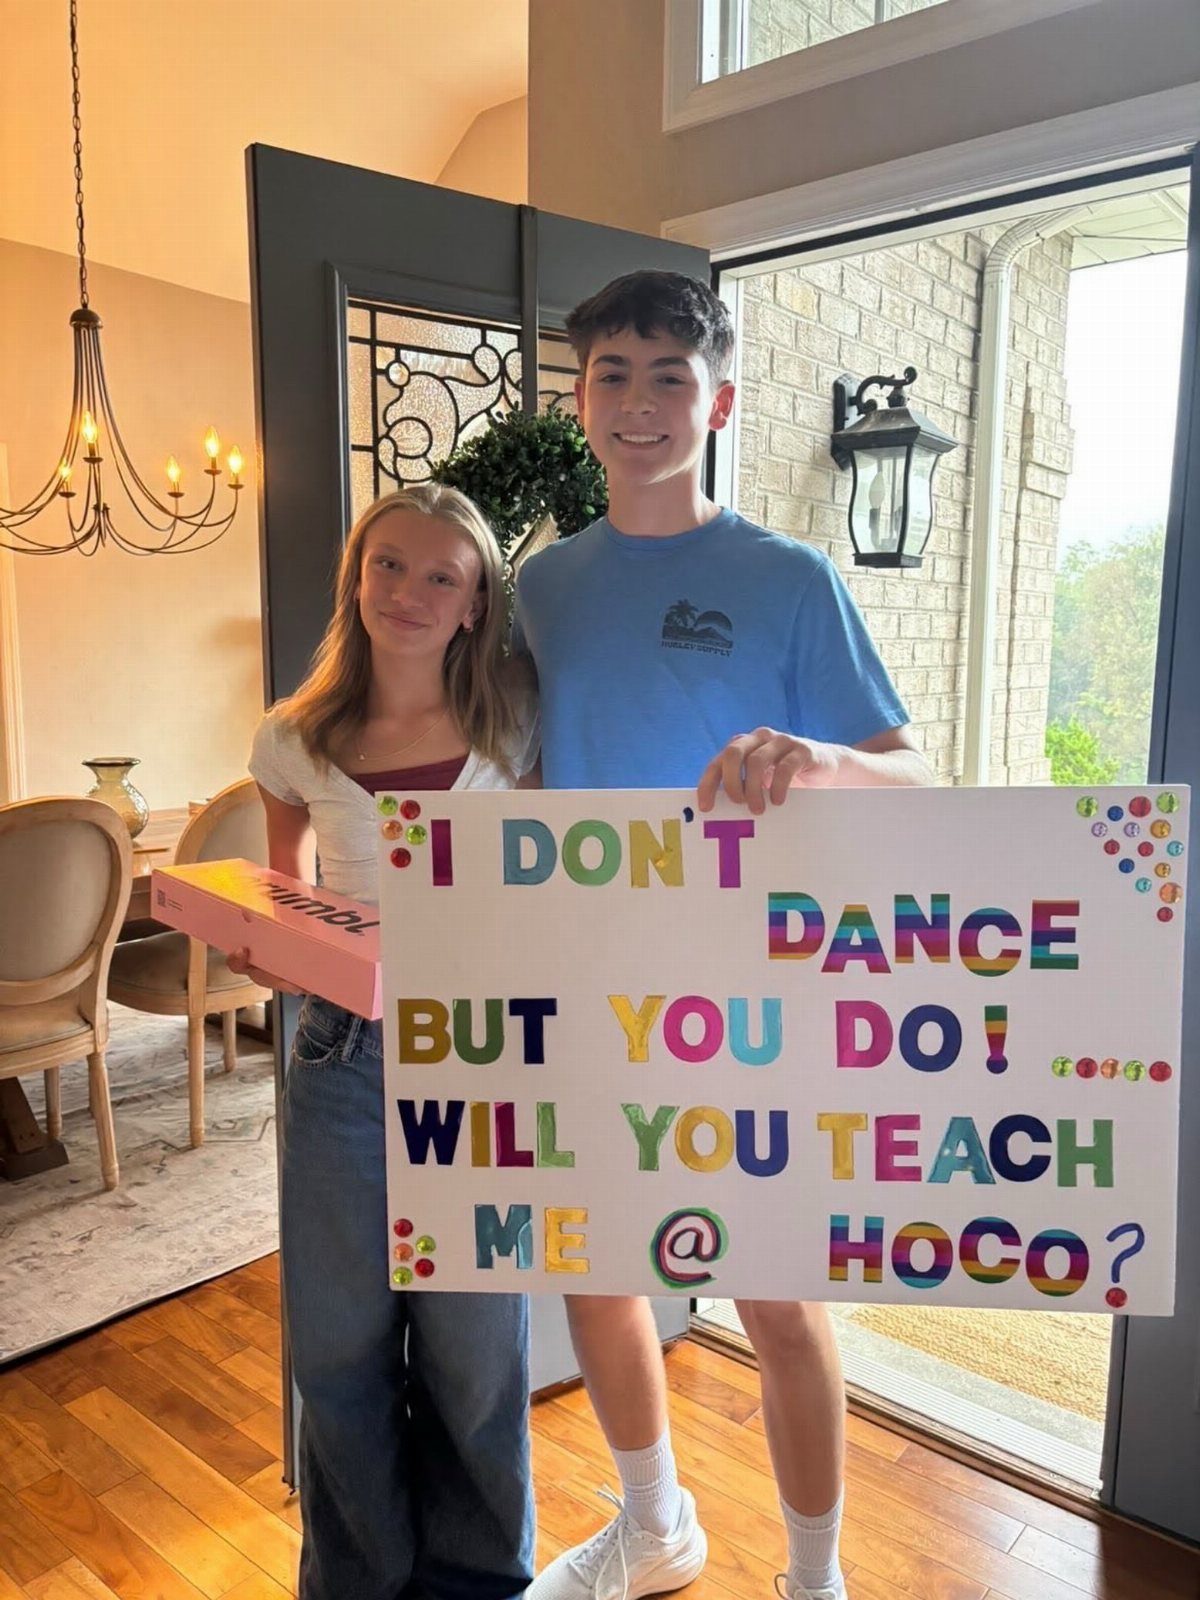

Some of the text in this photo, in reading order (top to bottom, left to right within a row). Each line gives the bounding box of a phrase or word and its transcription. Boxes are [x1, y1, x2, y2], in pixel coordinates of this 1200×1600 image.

[430, 806, 755, 888] I DON'T
[246, 875, 381, 936] rumbl
[767, 892, 1081, 977] DANCE
[397, 998, 558, 1065] BUT
[606, 994, 783, 1067] YOU
[396, 1099, 1115, 1188] WILL YOU TEACH
[473, 1203, 1146, 1308] ME @ HOCO?
